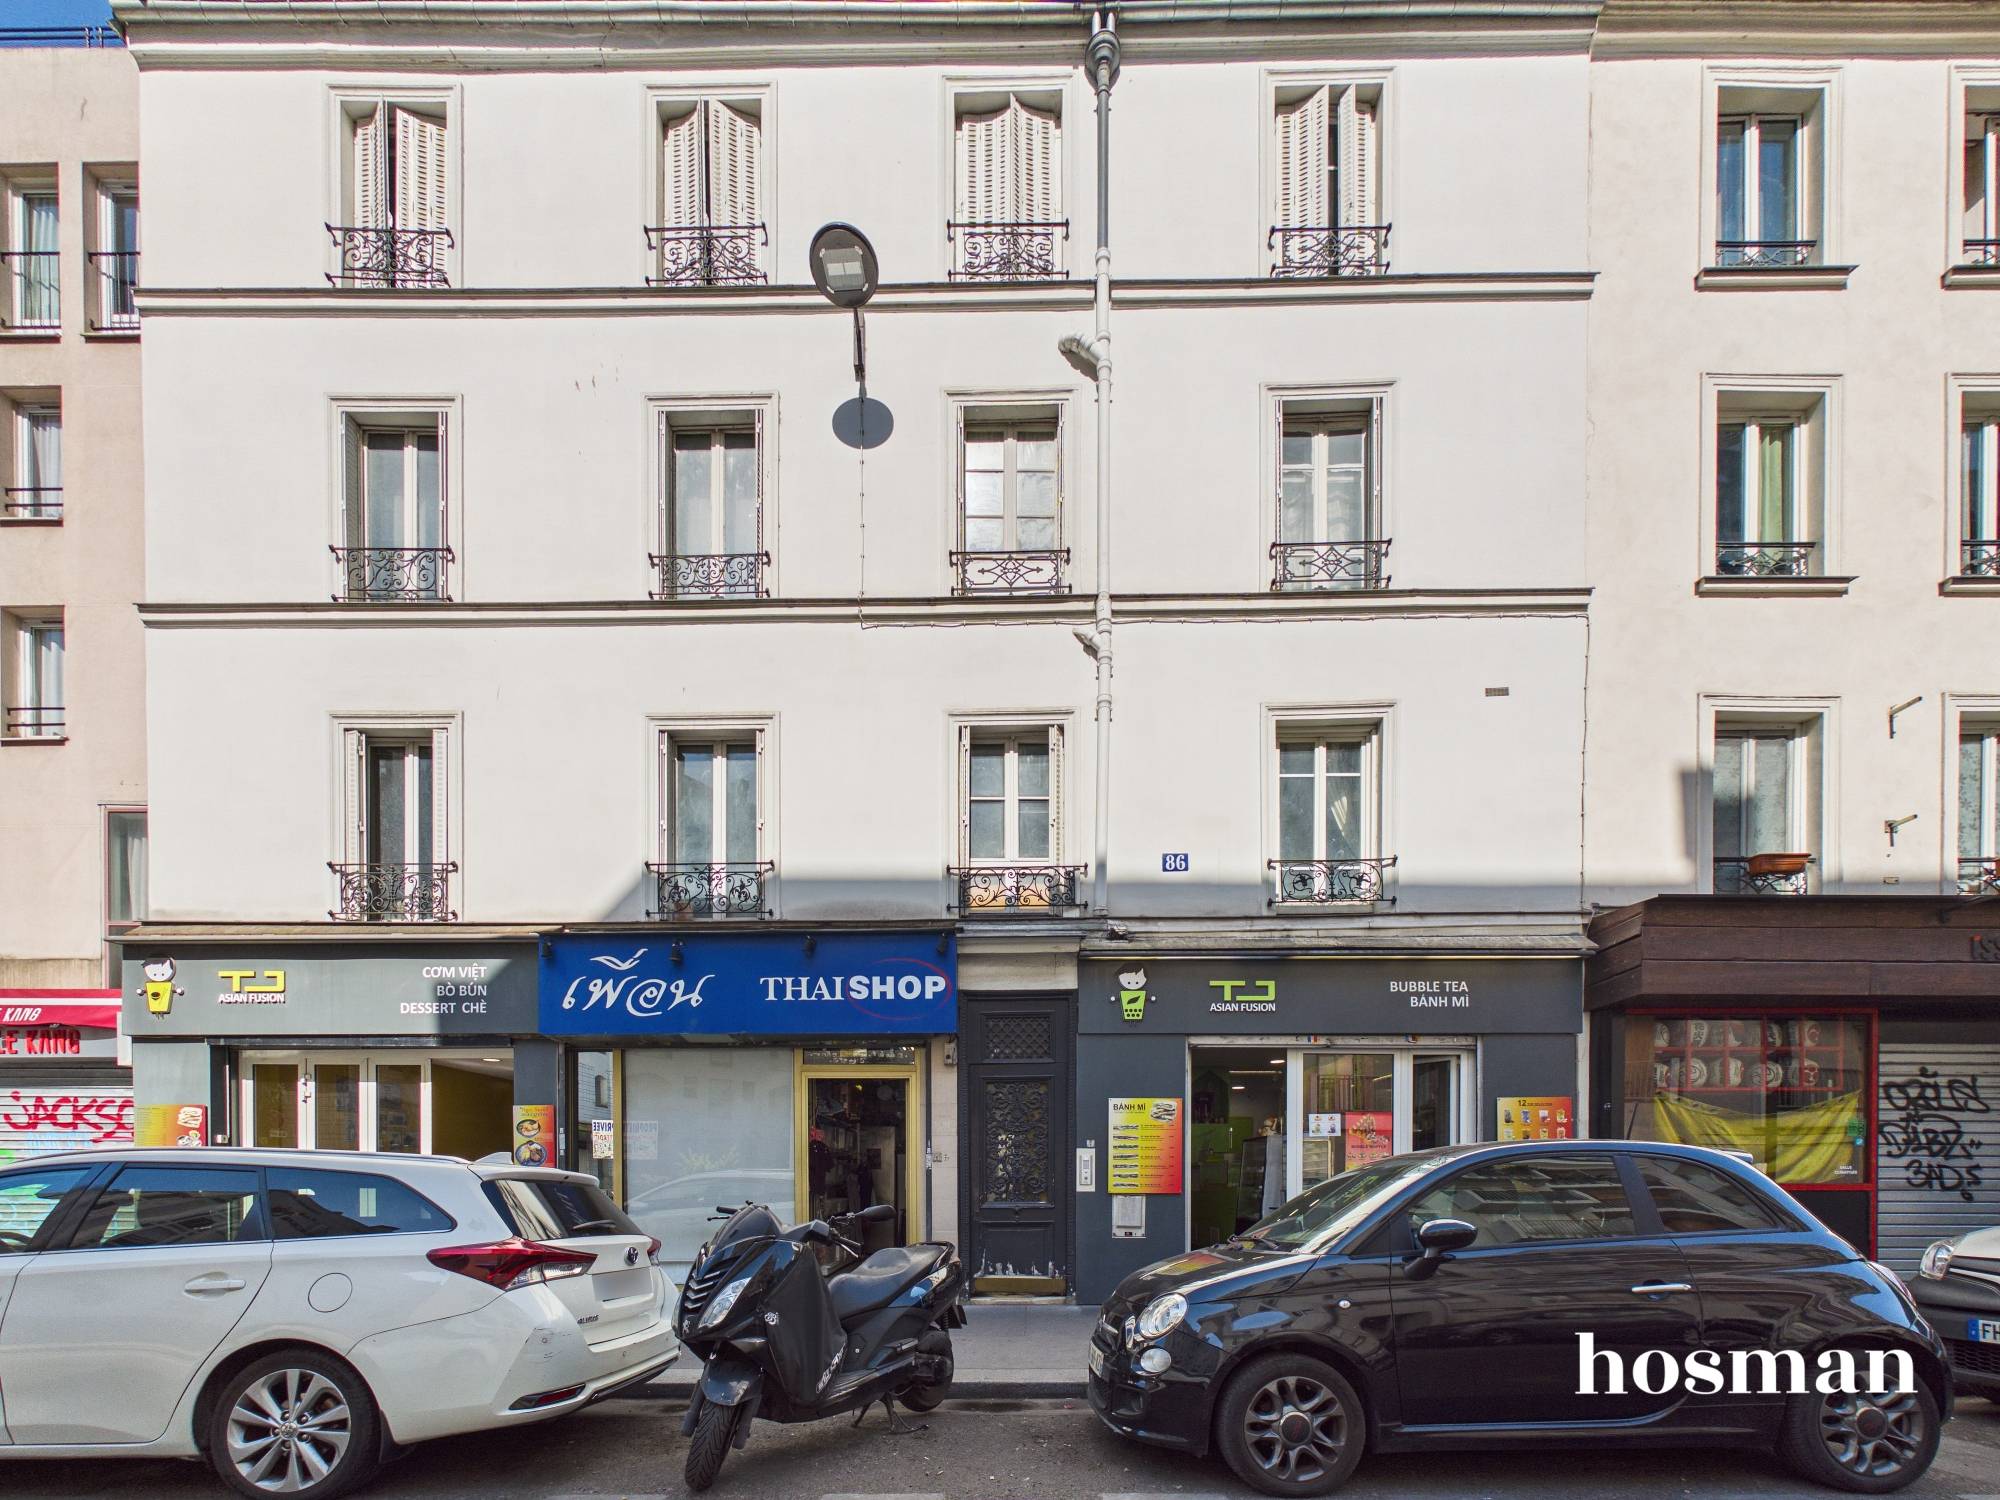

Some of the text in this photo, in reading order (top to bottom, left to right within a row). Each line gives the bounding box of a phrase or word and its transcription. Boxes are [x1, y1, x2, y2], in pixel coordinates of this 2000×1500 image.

[1165, 854, 1186, 870] 86
[422, 962, 487, 981] CƠM VIỆT
[218, 970, 286, 993] TJ
[437, 981, 487, 996] BÒ BÚN
[1390, 981, 1469, 992] BUBBLE TEA
[218, 993, 285, 1003] ASIAN FUSION
[1209, 980, 1276, 1001] TJ
[400, 999, 487, 1014] DESSERT CHÈ
[1209, 1003, 1276, 1012] ASIAN FUSION
[1410, 993, 1448, 1008] BÁNH
